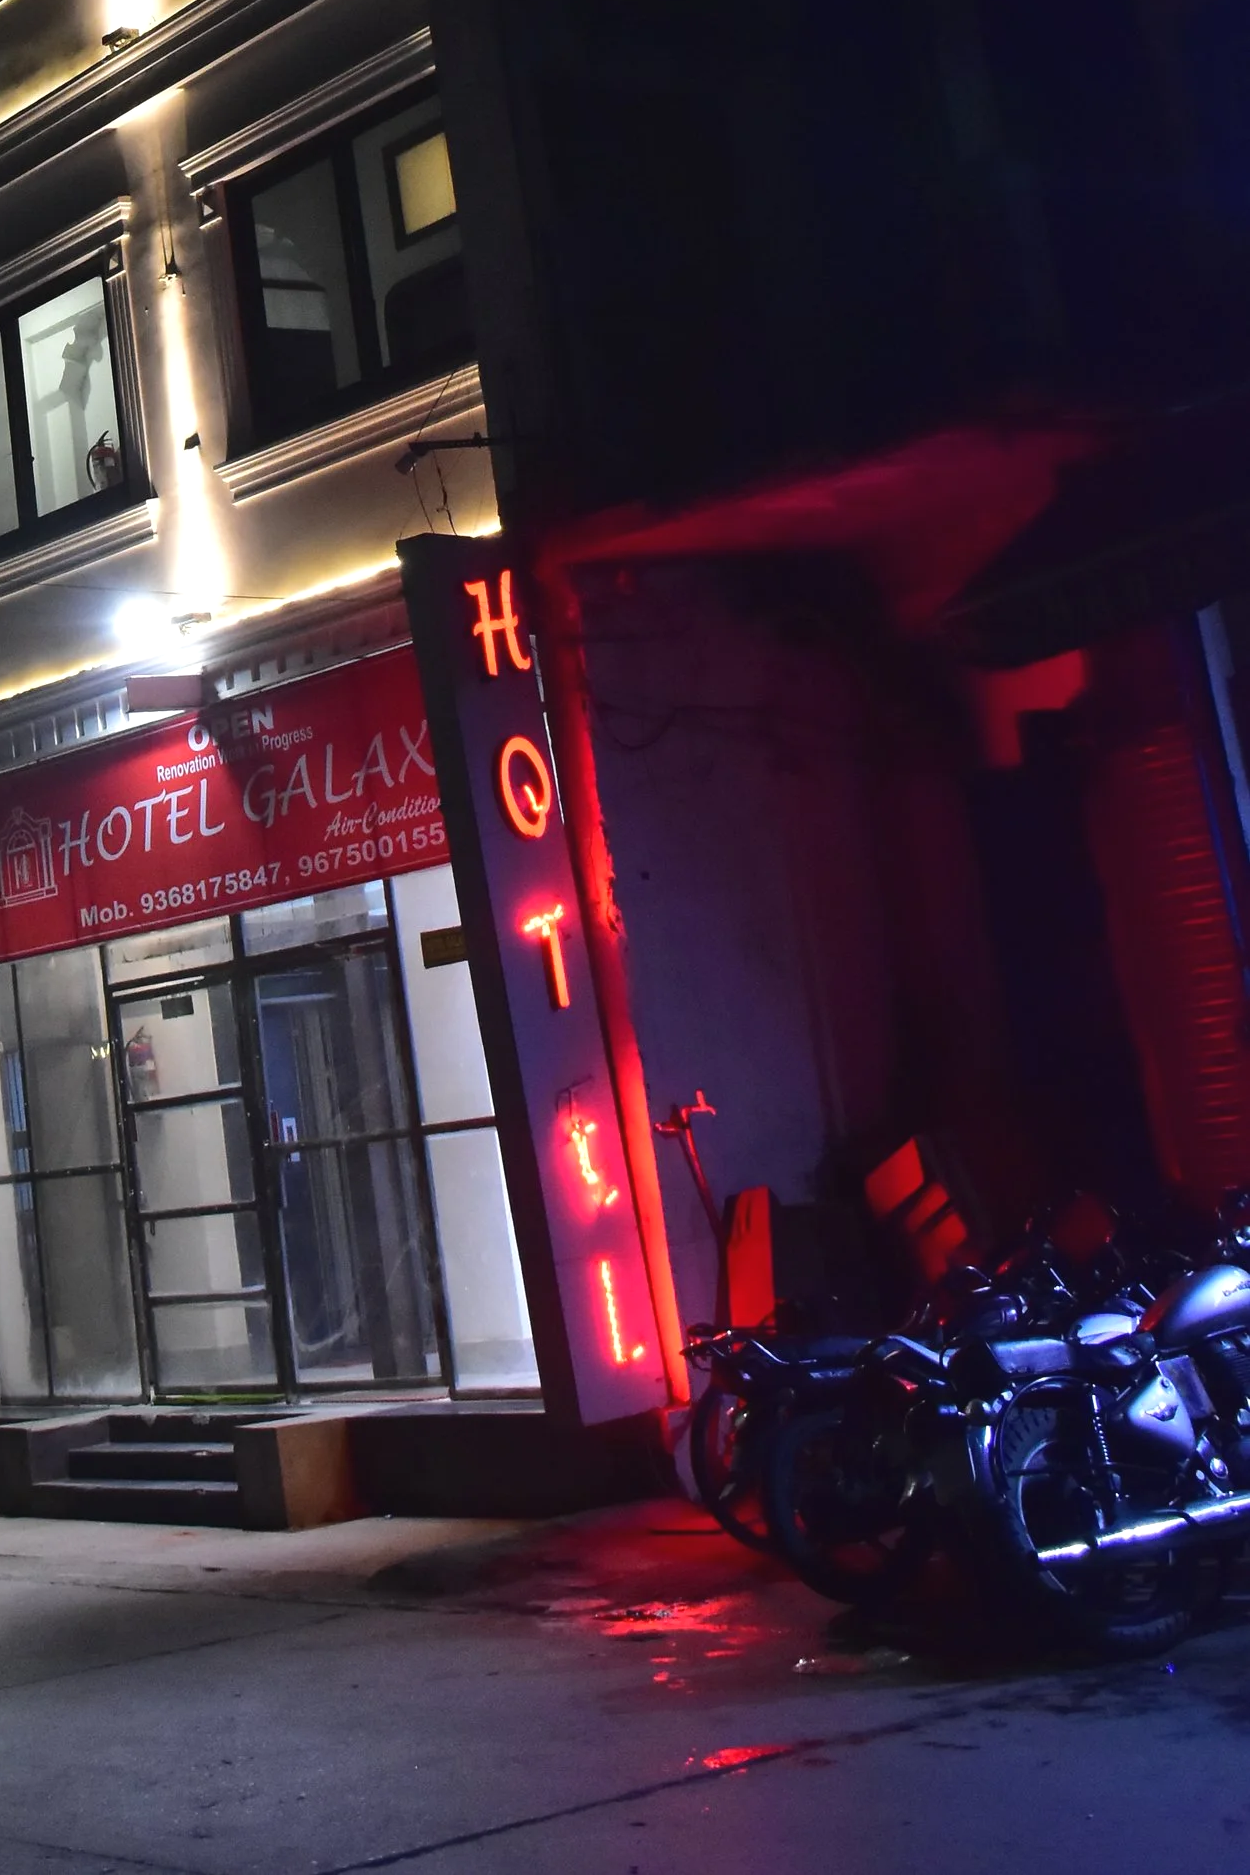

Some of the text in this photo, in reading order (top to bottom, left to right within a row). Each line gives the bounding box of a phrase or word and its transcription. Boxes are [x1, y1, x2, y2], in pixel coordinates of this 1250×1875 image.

[156, 753, 216, 783] Renovation
[261, 725, 314, 752] Progress
[187, 704, 275, 752] OPEN
[58, 777, 226, 877] HOTEL
[80, 894, 134, 928] Mob.
[140, 860, 291, 915] 9368175847,
